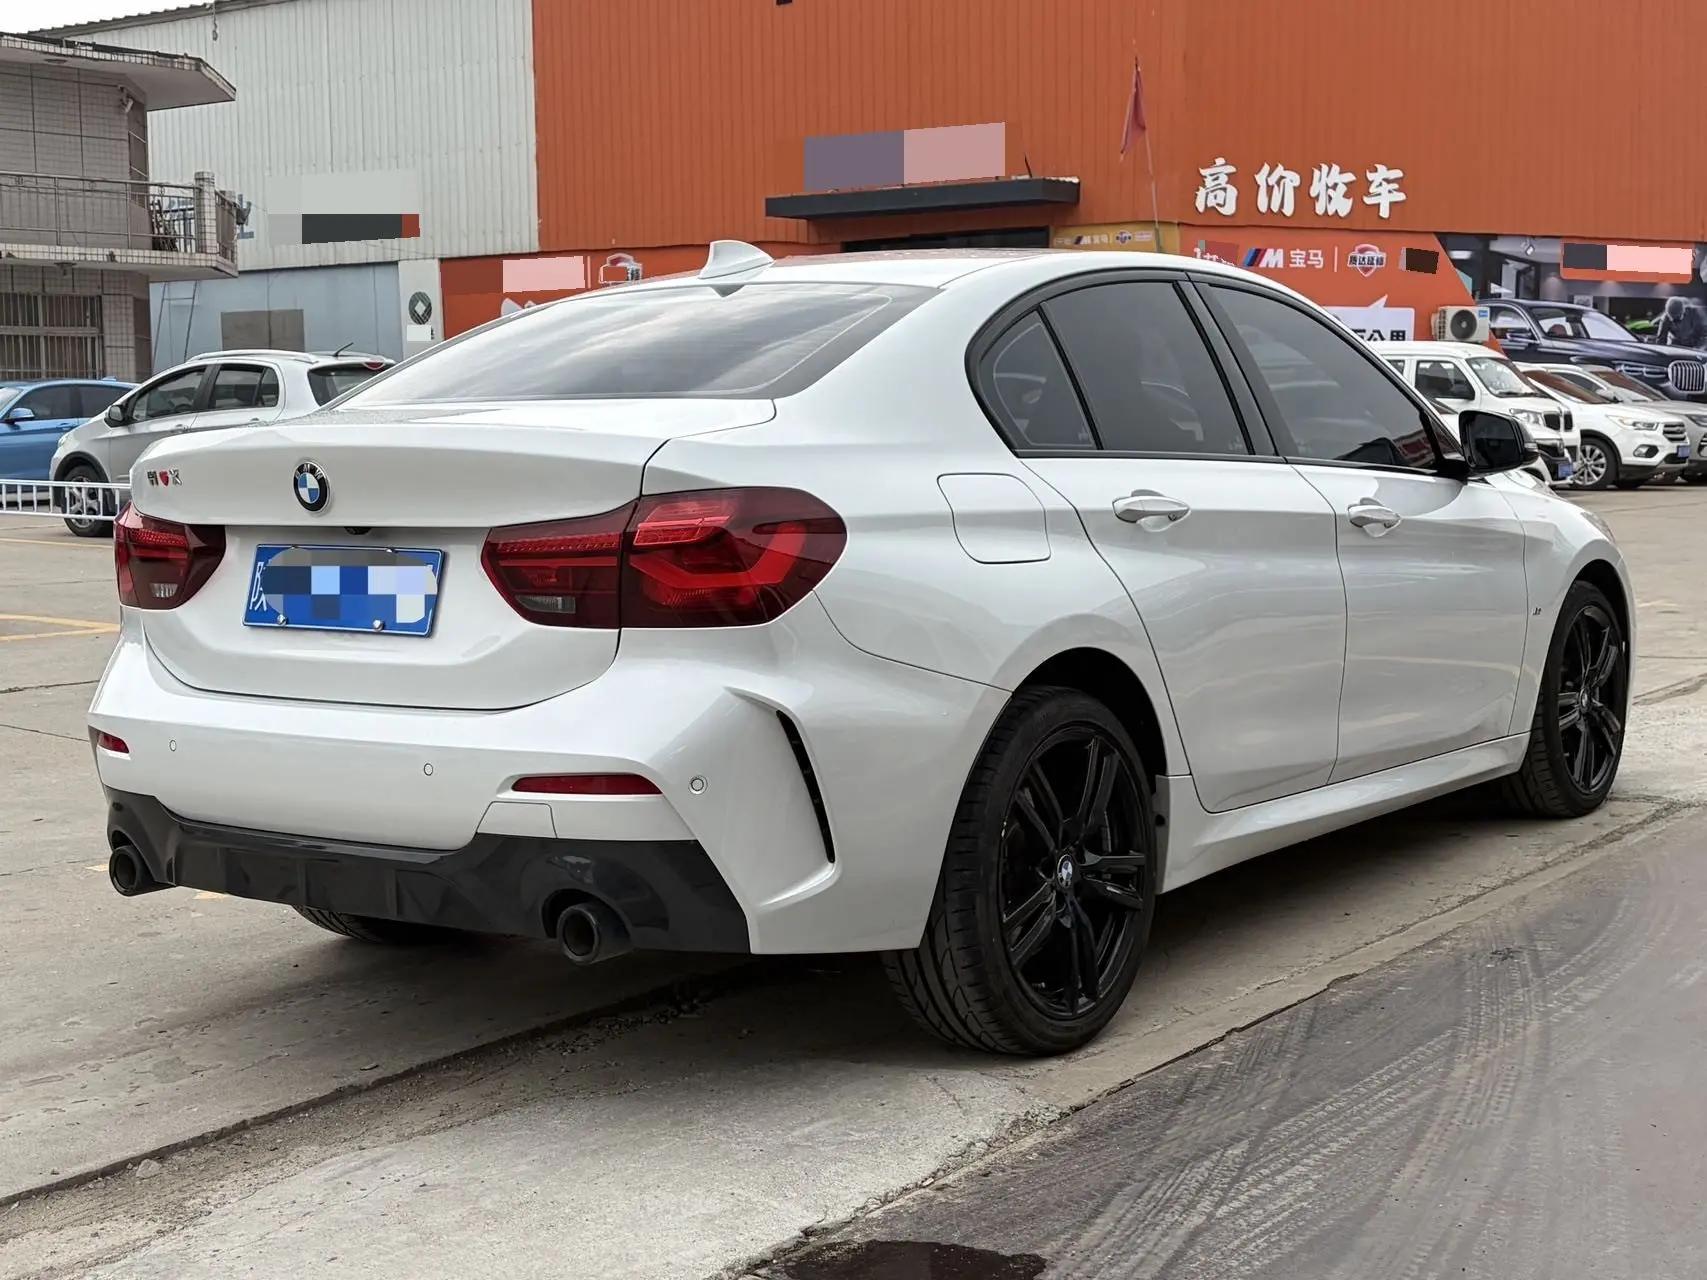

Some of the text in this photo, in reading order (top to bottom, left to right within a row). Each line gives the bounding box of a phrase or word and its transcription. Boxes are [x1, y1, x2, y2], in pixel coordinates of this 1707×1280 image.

[1195, 157, 1407, 219] 高价收车
[1288, 248, 1324, 269] 宝马
